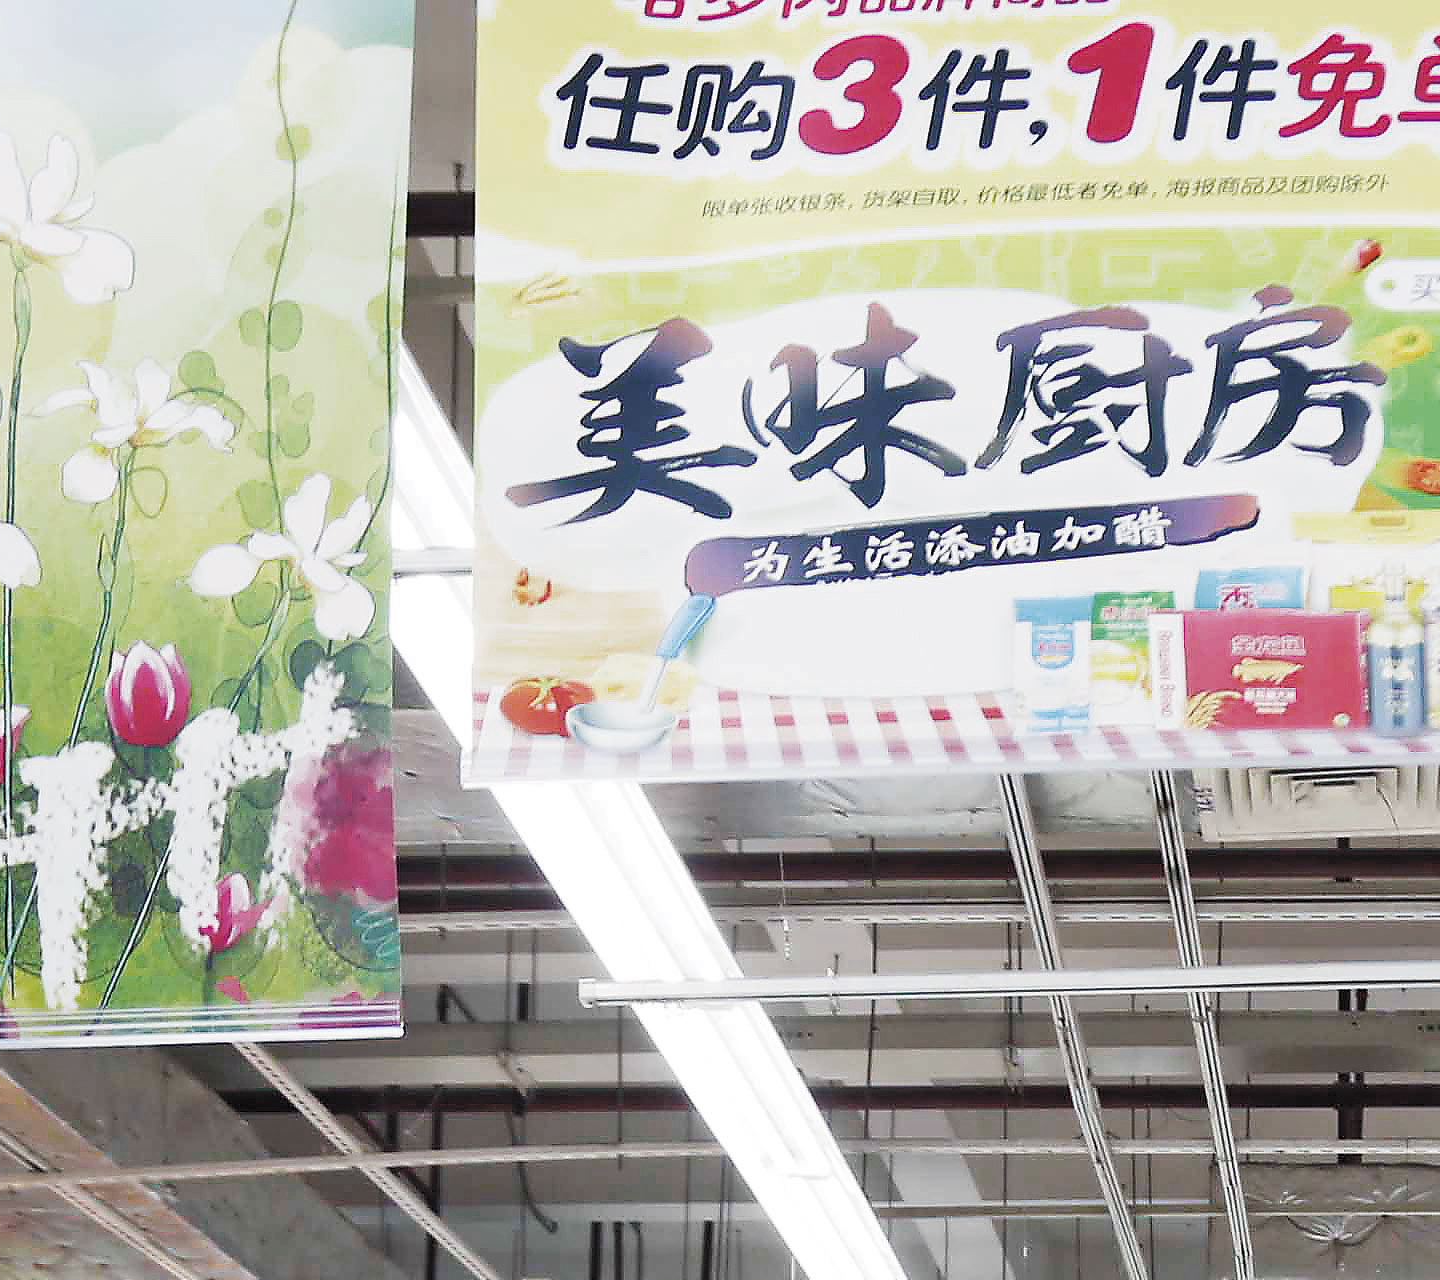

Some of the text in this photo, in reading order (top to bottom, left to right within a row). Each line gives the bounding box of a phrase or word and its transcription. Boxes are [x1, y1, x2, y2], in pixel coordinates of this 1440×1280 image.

[505, 285, 1389, 529] 美味厨房
[742, 505, 1173, 587] 为生活添油加醋
